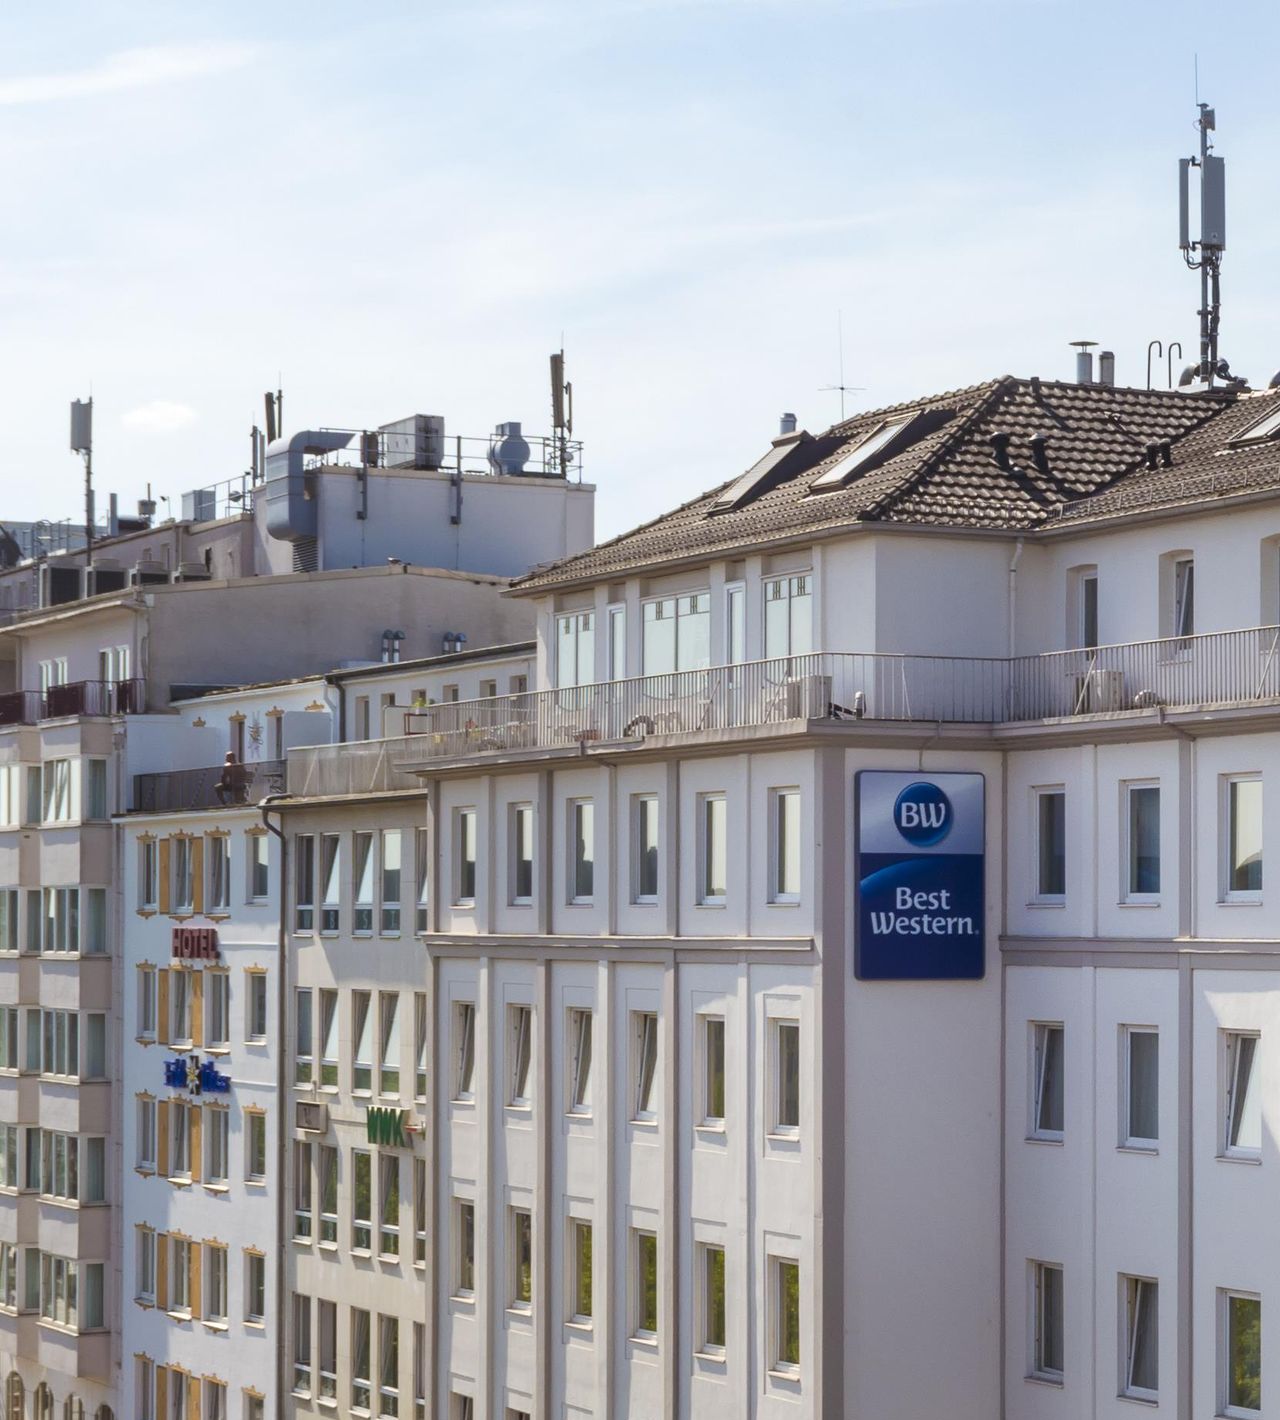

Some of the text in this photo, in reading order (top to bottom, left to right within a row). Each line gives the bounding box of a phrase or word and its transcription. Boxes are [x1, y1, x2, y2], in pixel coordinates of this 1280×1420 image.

[901, 802, 945, 828] BW
[896, 887, 950, 910] Best
[871, 912, 973, 935] Western
[173, 928, 217, 959] HOTEL
